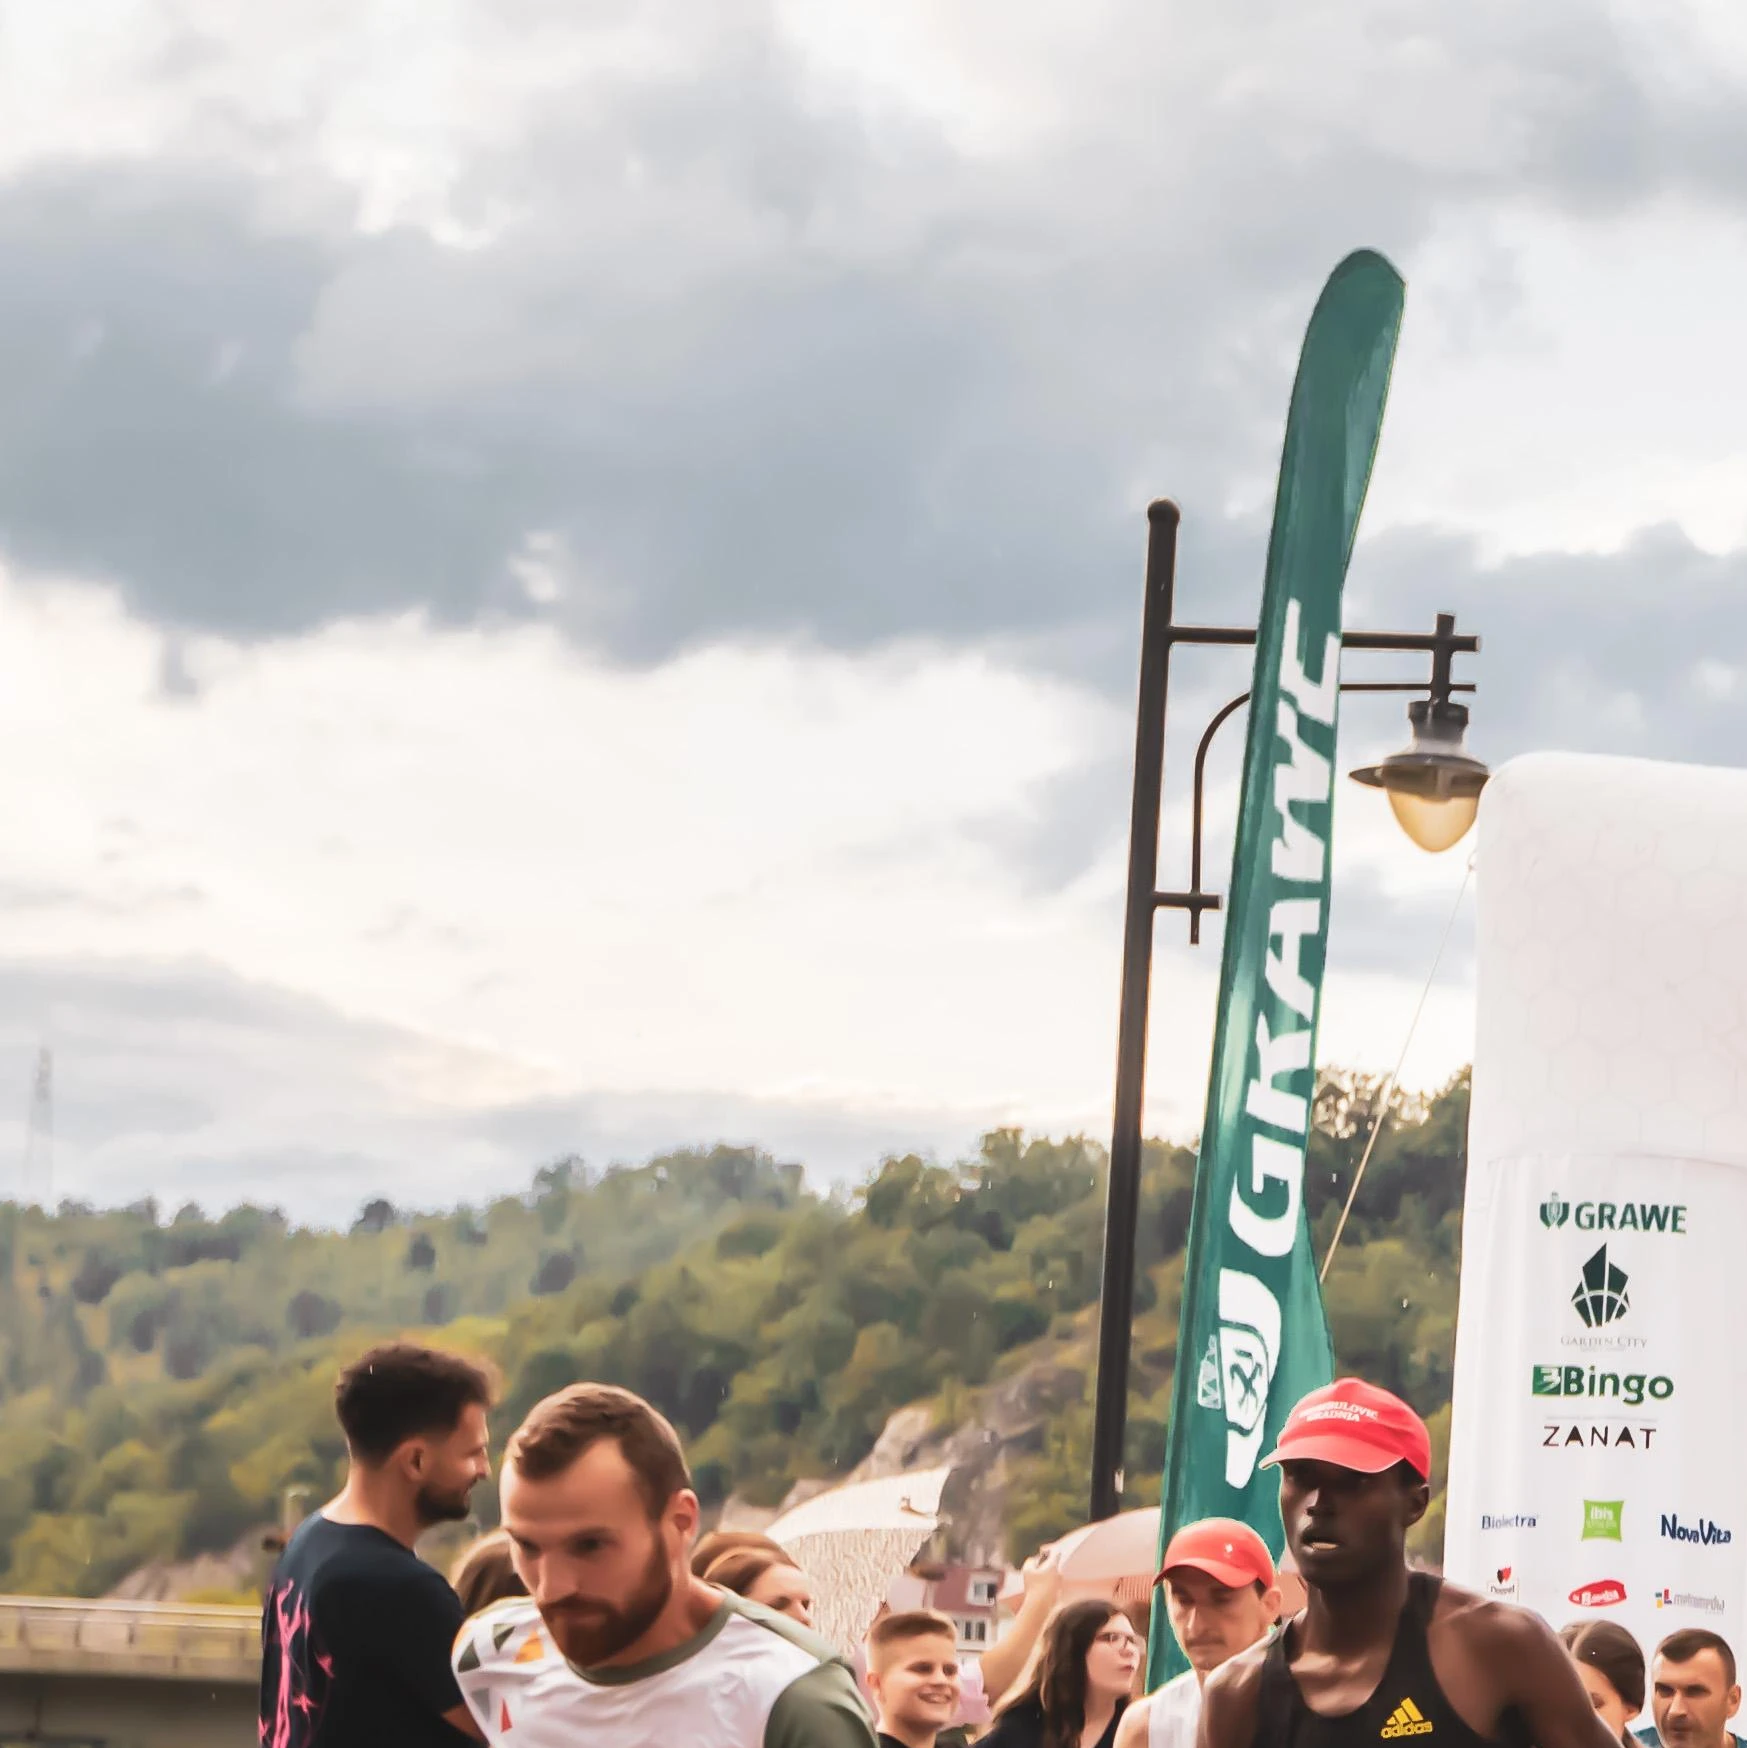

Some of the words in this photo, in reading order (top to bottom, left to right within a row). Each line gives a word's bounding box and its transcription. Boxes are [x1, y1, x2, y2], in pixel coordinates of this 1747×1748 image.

[1574, 1202, 1688, 1235] GRAWE
[1563, 1365, 1675, 1407] Bingo
[1542, 1425, 1658, 1450] ZANAT
[1660, 1513, 1732, 1546] NovaVita
[1380, 1721, 1433, 1739] adidas
